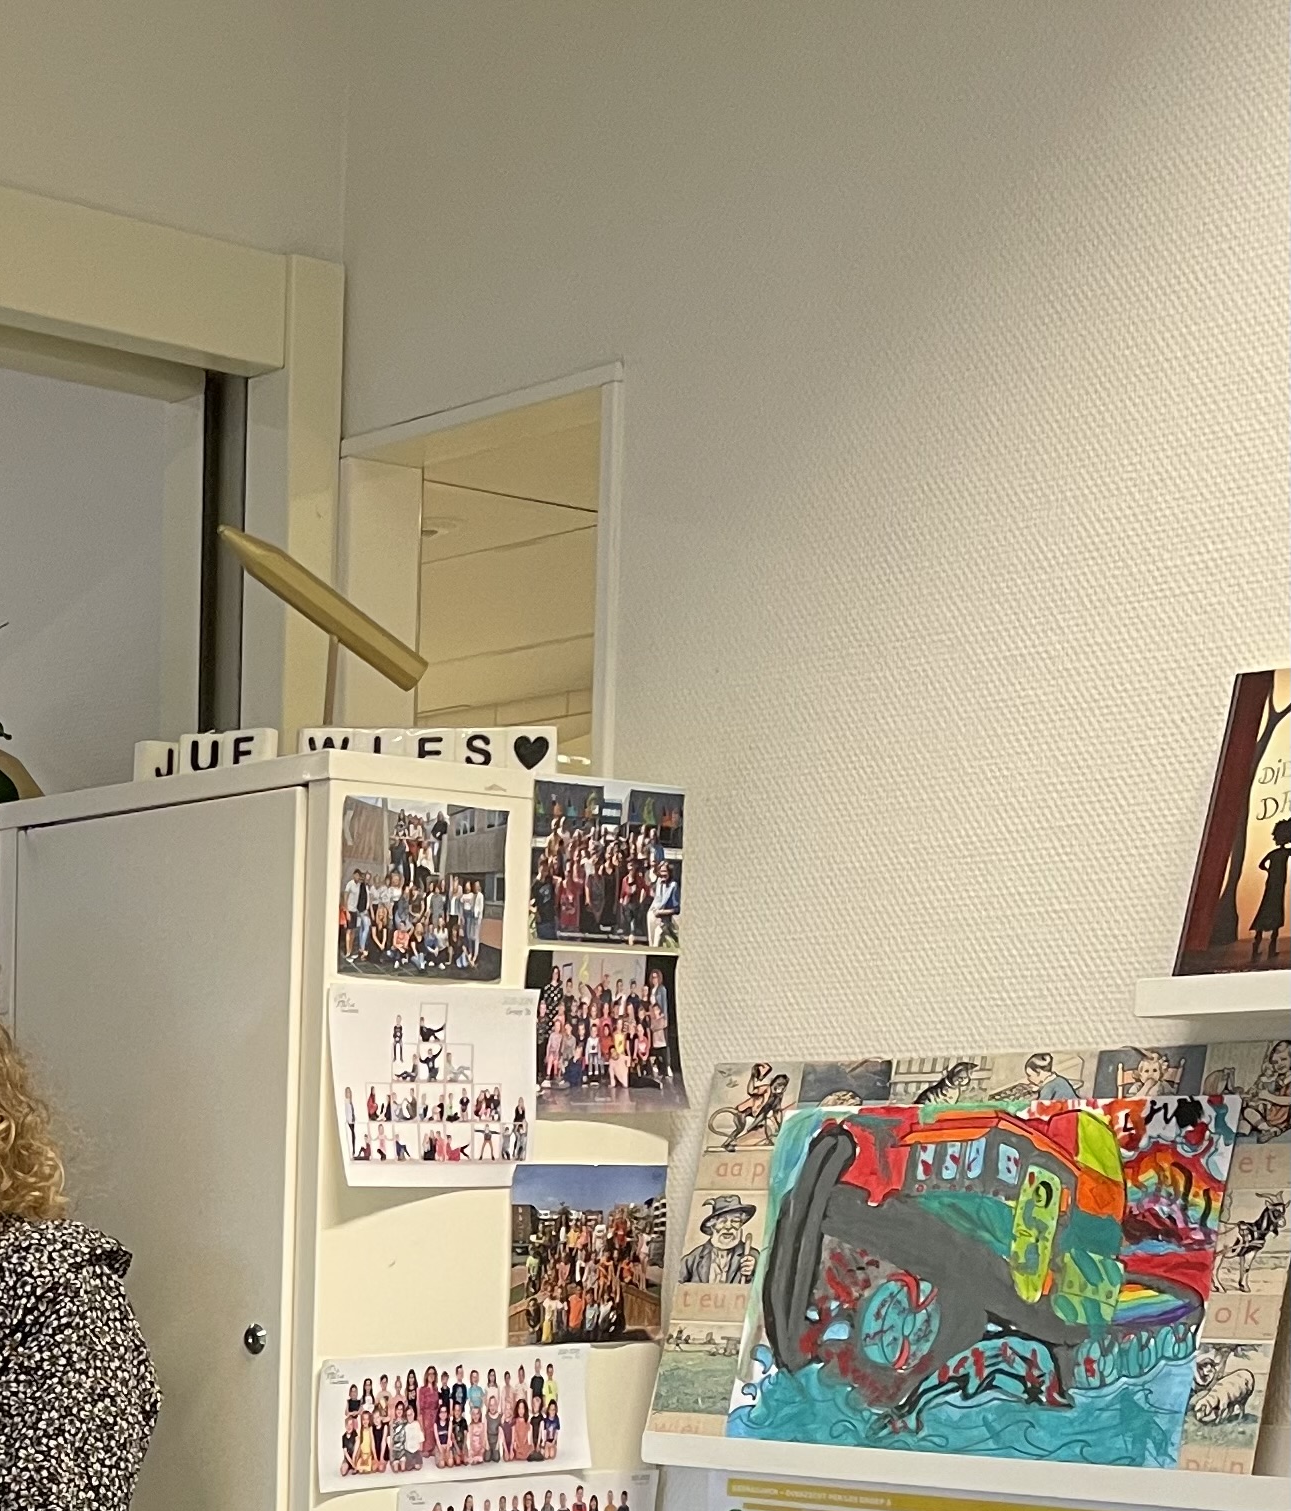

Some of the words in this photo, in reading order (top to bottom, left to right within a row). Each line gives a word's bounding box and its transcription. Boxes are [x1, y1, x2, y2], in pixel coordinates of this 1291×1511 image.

[155, 736, 254, 778] JUF
[716, 1162, 766, 1184] aap
[1238, 1153, 1277, 1174] et
[683, 1290, 746, 1308] teun
[1214, 1300, 1261, 1325] ok
